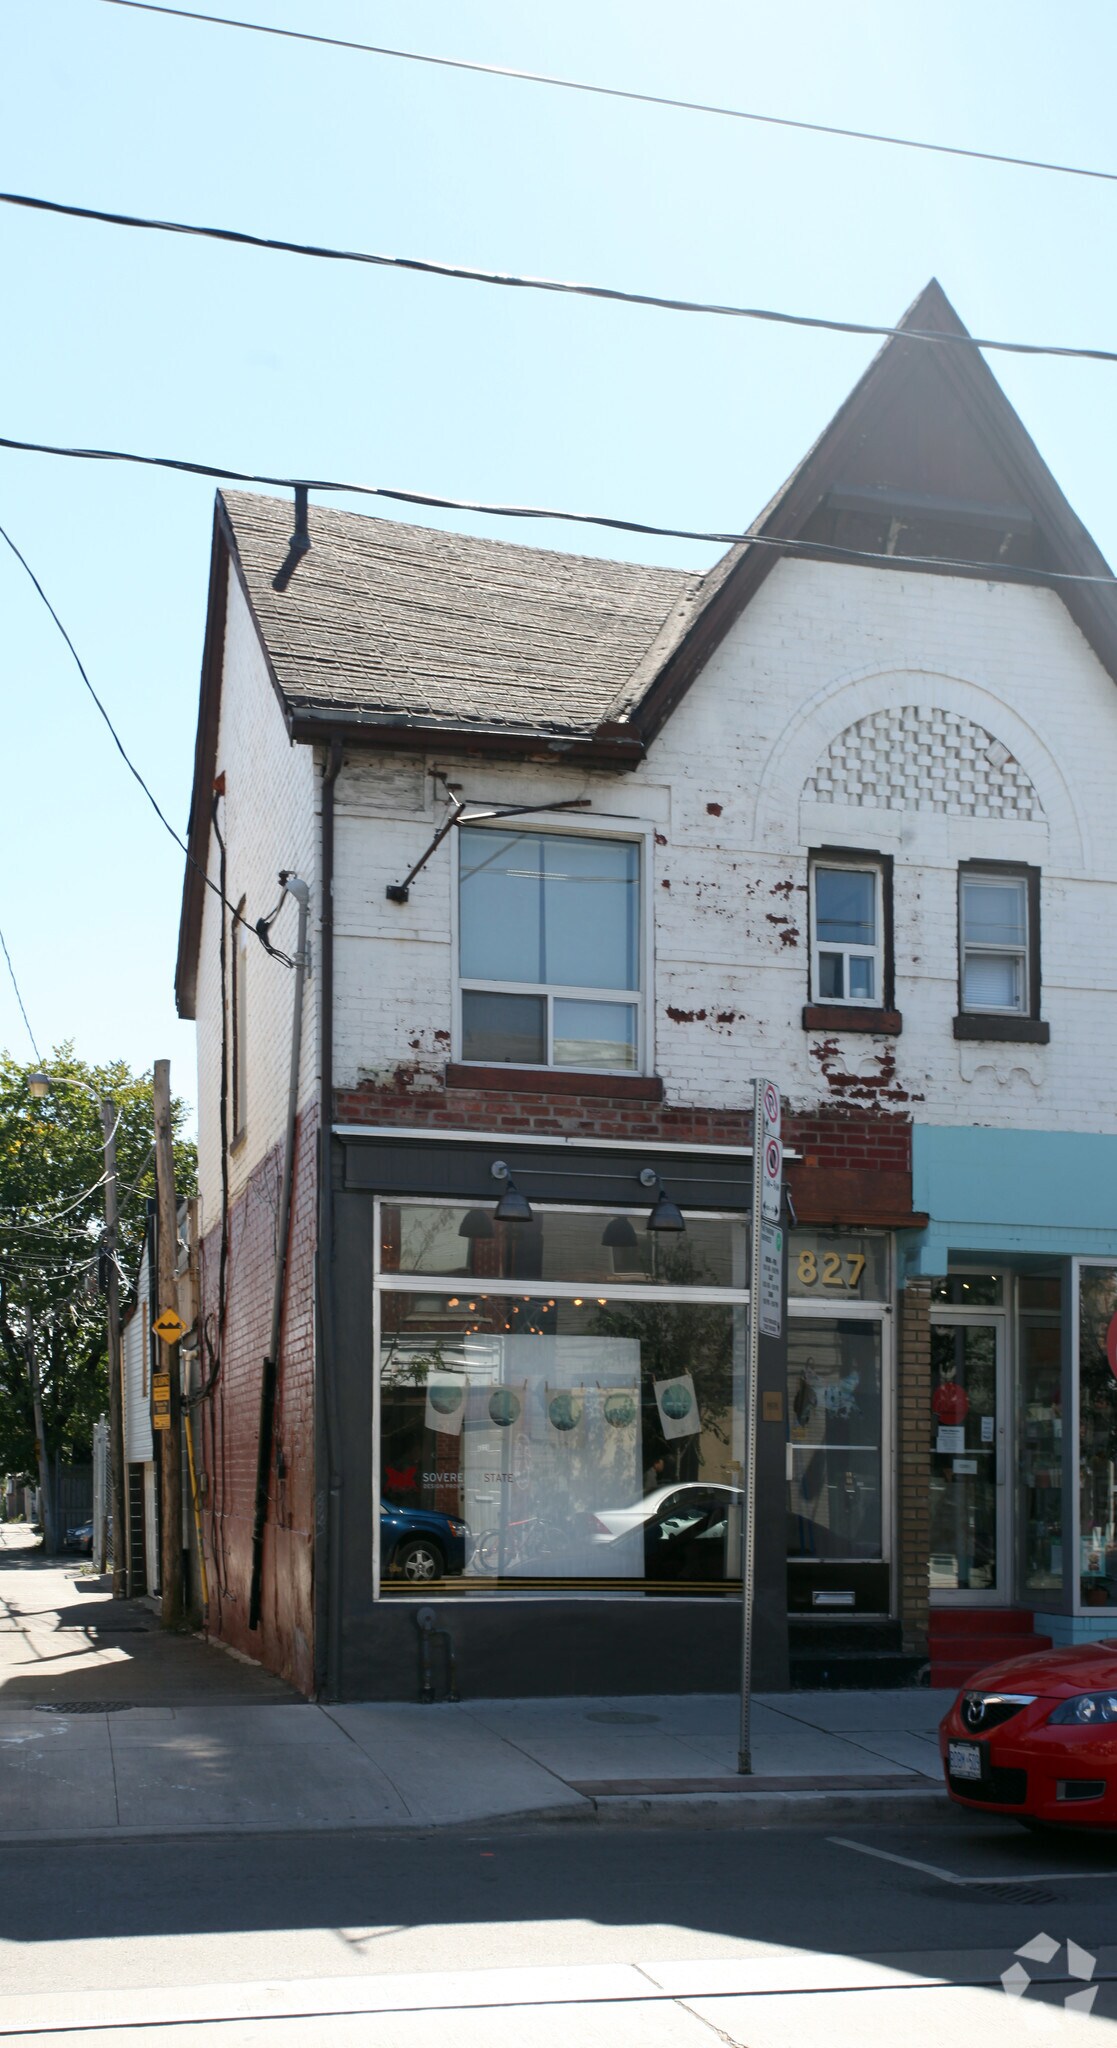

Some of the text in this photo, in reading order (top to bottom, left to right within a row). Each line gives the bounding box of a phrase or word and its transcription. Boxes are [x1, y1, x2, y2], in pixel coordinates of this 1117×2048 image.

[797, 1250, 866, 1286] 827
[422, 1472, 514, 1483] SOVERE STATE
